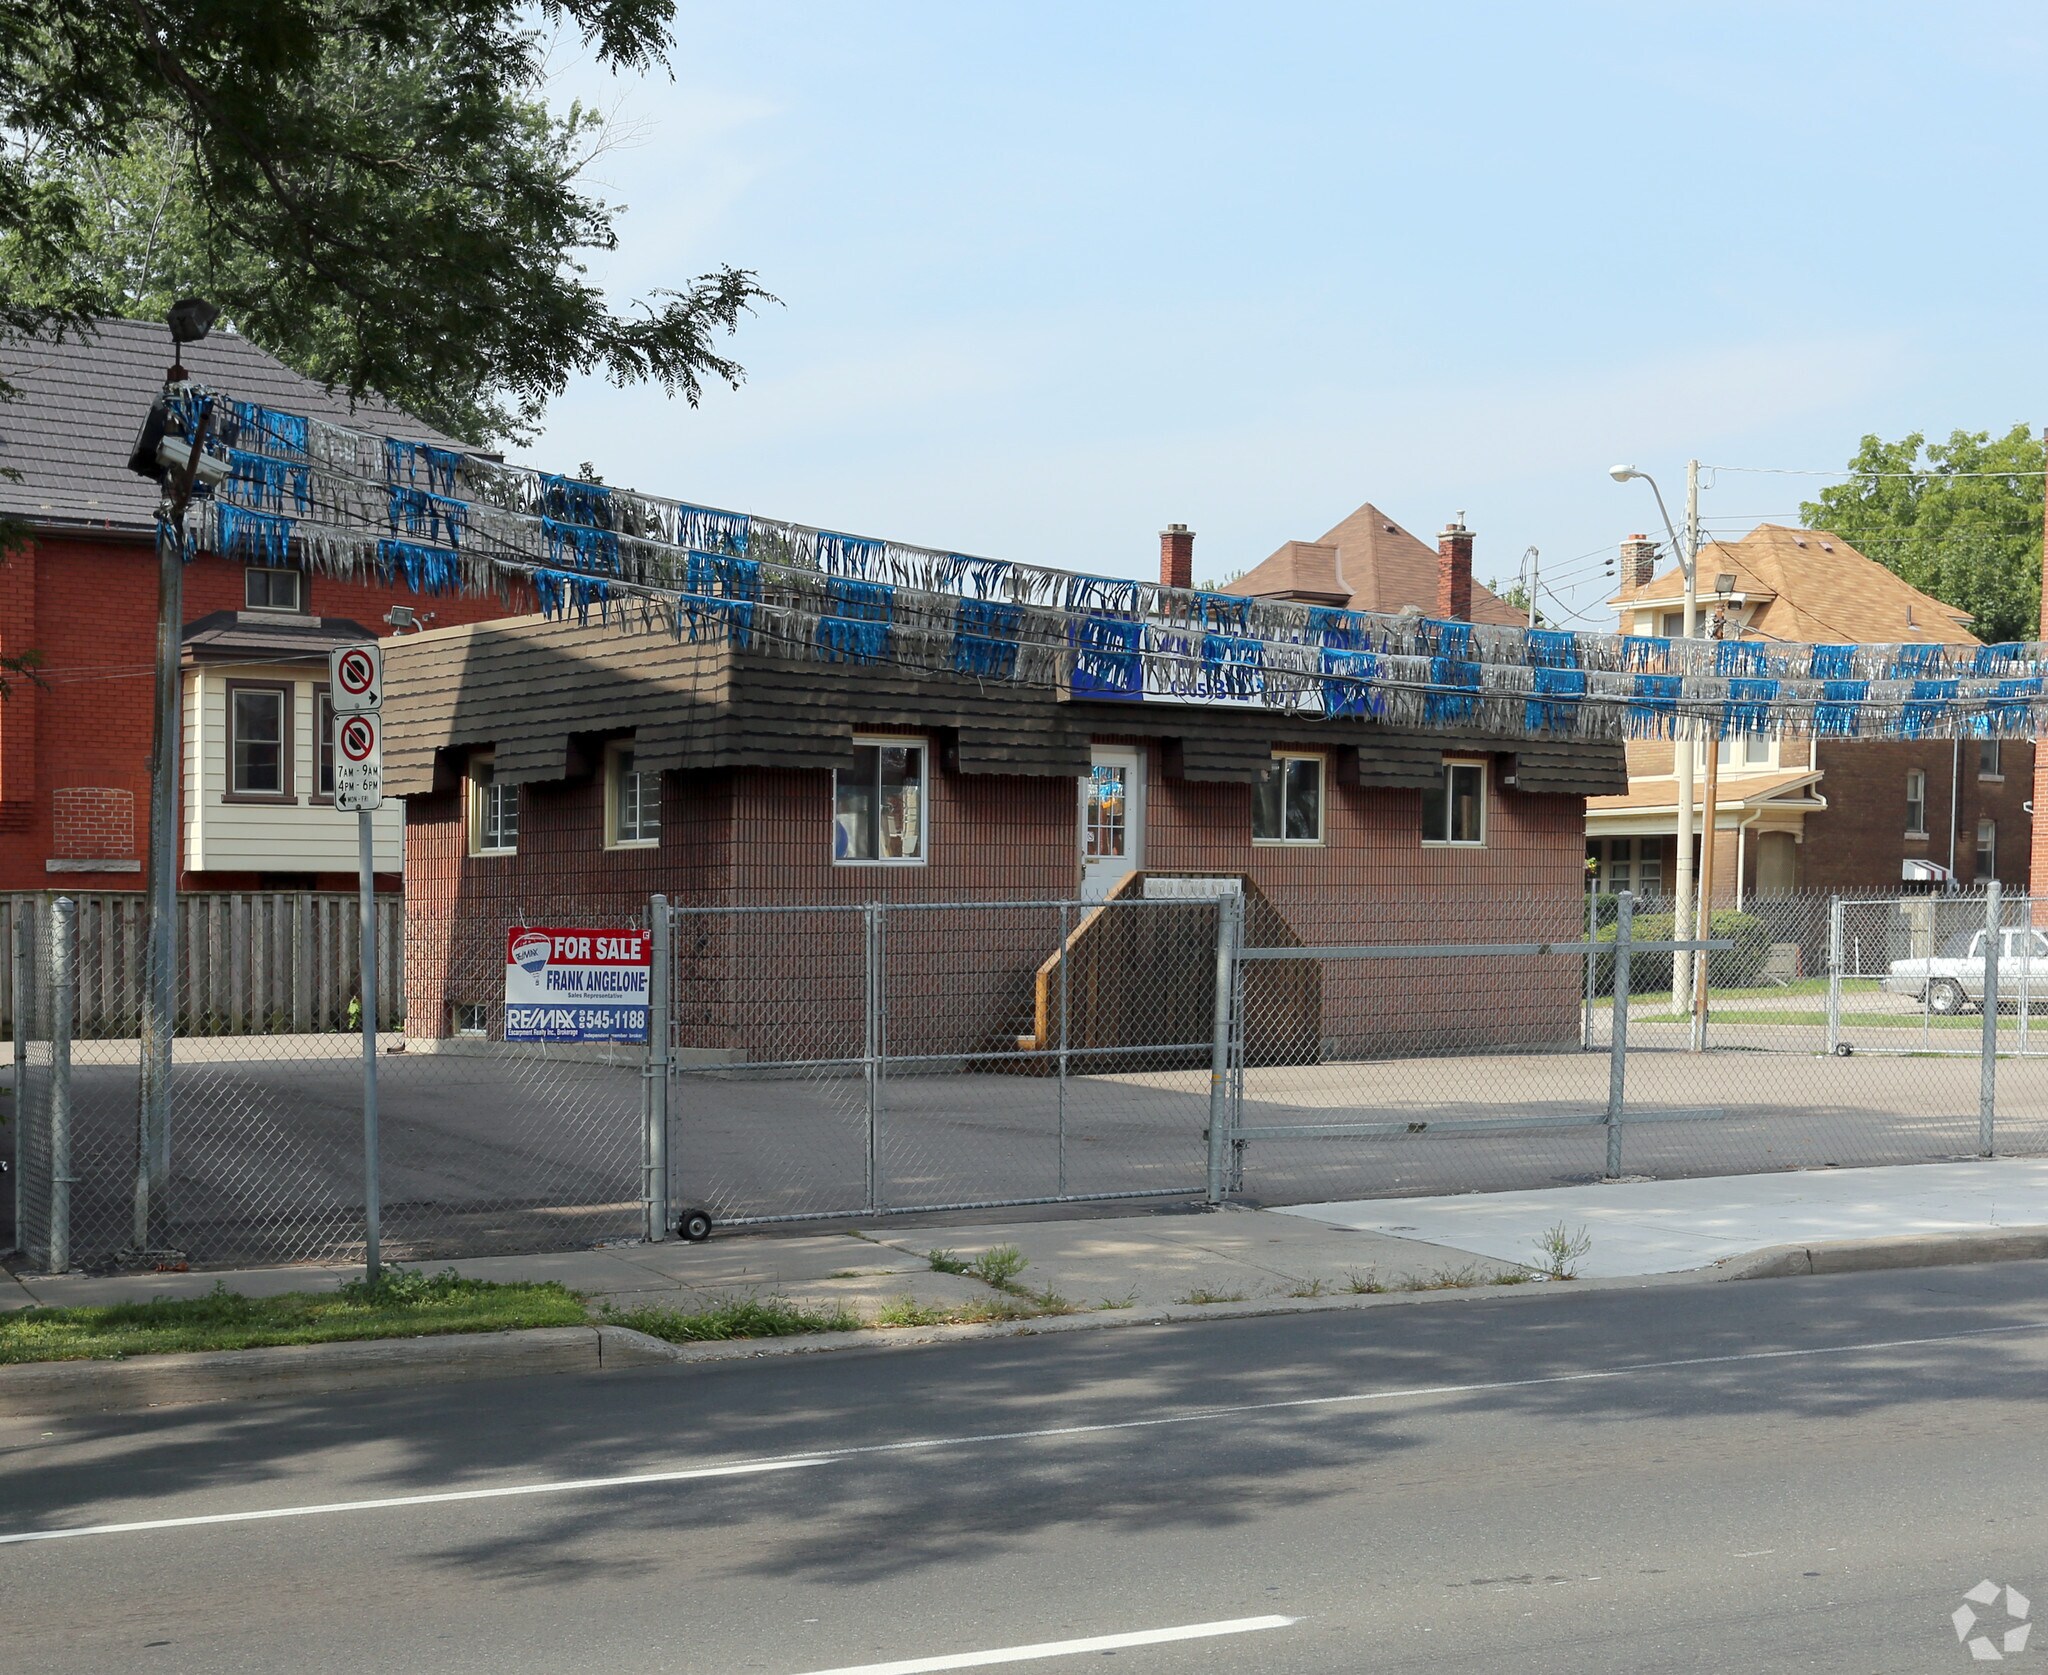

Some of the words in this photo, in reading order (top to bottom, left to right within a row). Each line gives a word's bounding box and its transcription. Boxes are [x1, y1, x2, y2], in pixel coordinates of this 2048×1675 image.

[338, 766, 354, 777] 7AM
[362, 764, 378, 775] 9AM
[338, 780, 354, 791] 4PM
[362, 780, 377, 790] 6PM
[554, 936, 590, 960] FOR
[596, 937, 642, 960] SALE
[546, 970, 582, 990] FRANK
[584, 970, 645, 992] ANGELONE
[508, 1008, 577, 1028] RE/MAX
[586, 1010, 645, 1029] 545-1188
